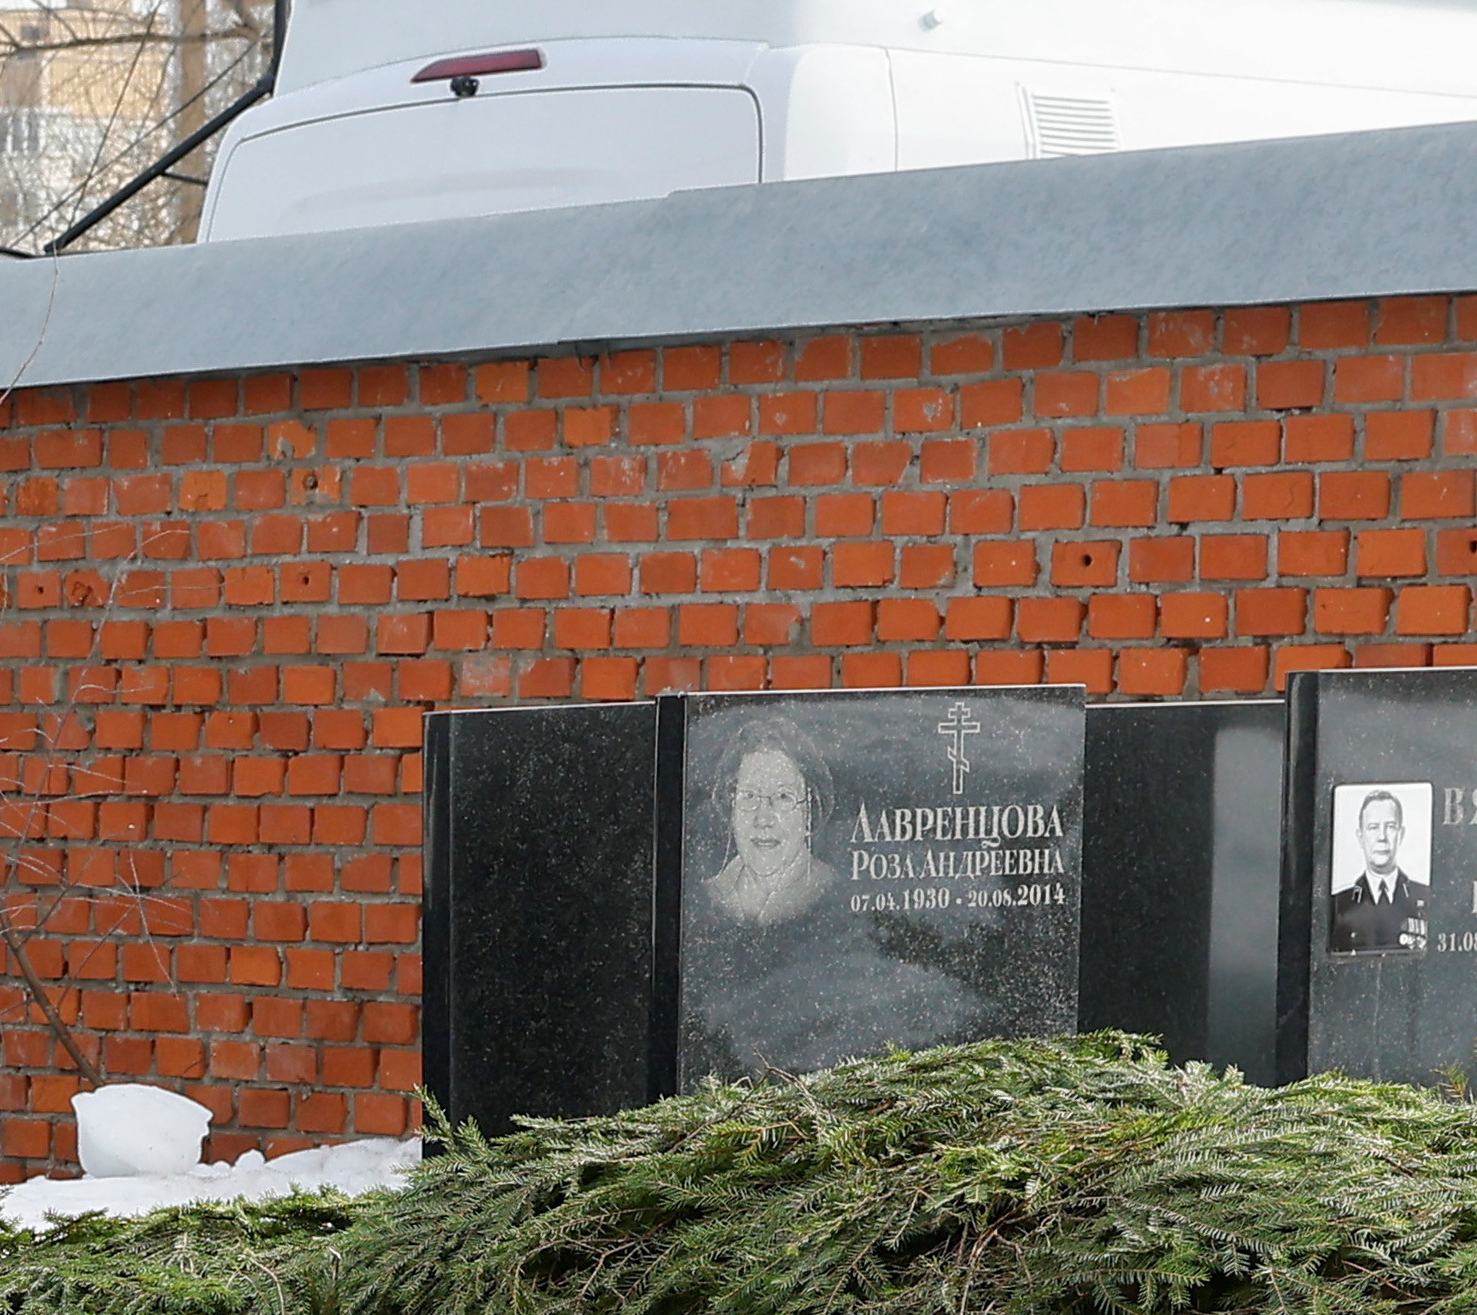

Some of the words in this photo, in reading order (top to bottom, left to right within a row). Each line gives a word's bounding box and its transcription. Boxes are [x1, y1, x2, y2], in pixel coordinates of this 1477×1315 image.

[850, 801, 1063, 848] ЛАВРЕНЦОВА
[851, 849, 914, 881] РОЗА
[920, 848, 1065, 880] АНДРЕЕВНА
[850, 888, 949, 912] 07.04.1930
[968, 882, 1065, 908] 20.08.2014
